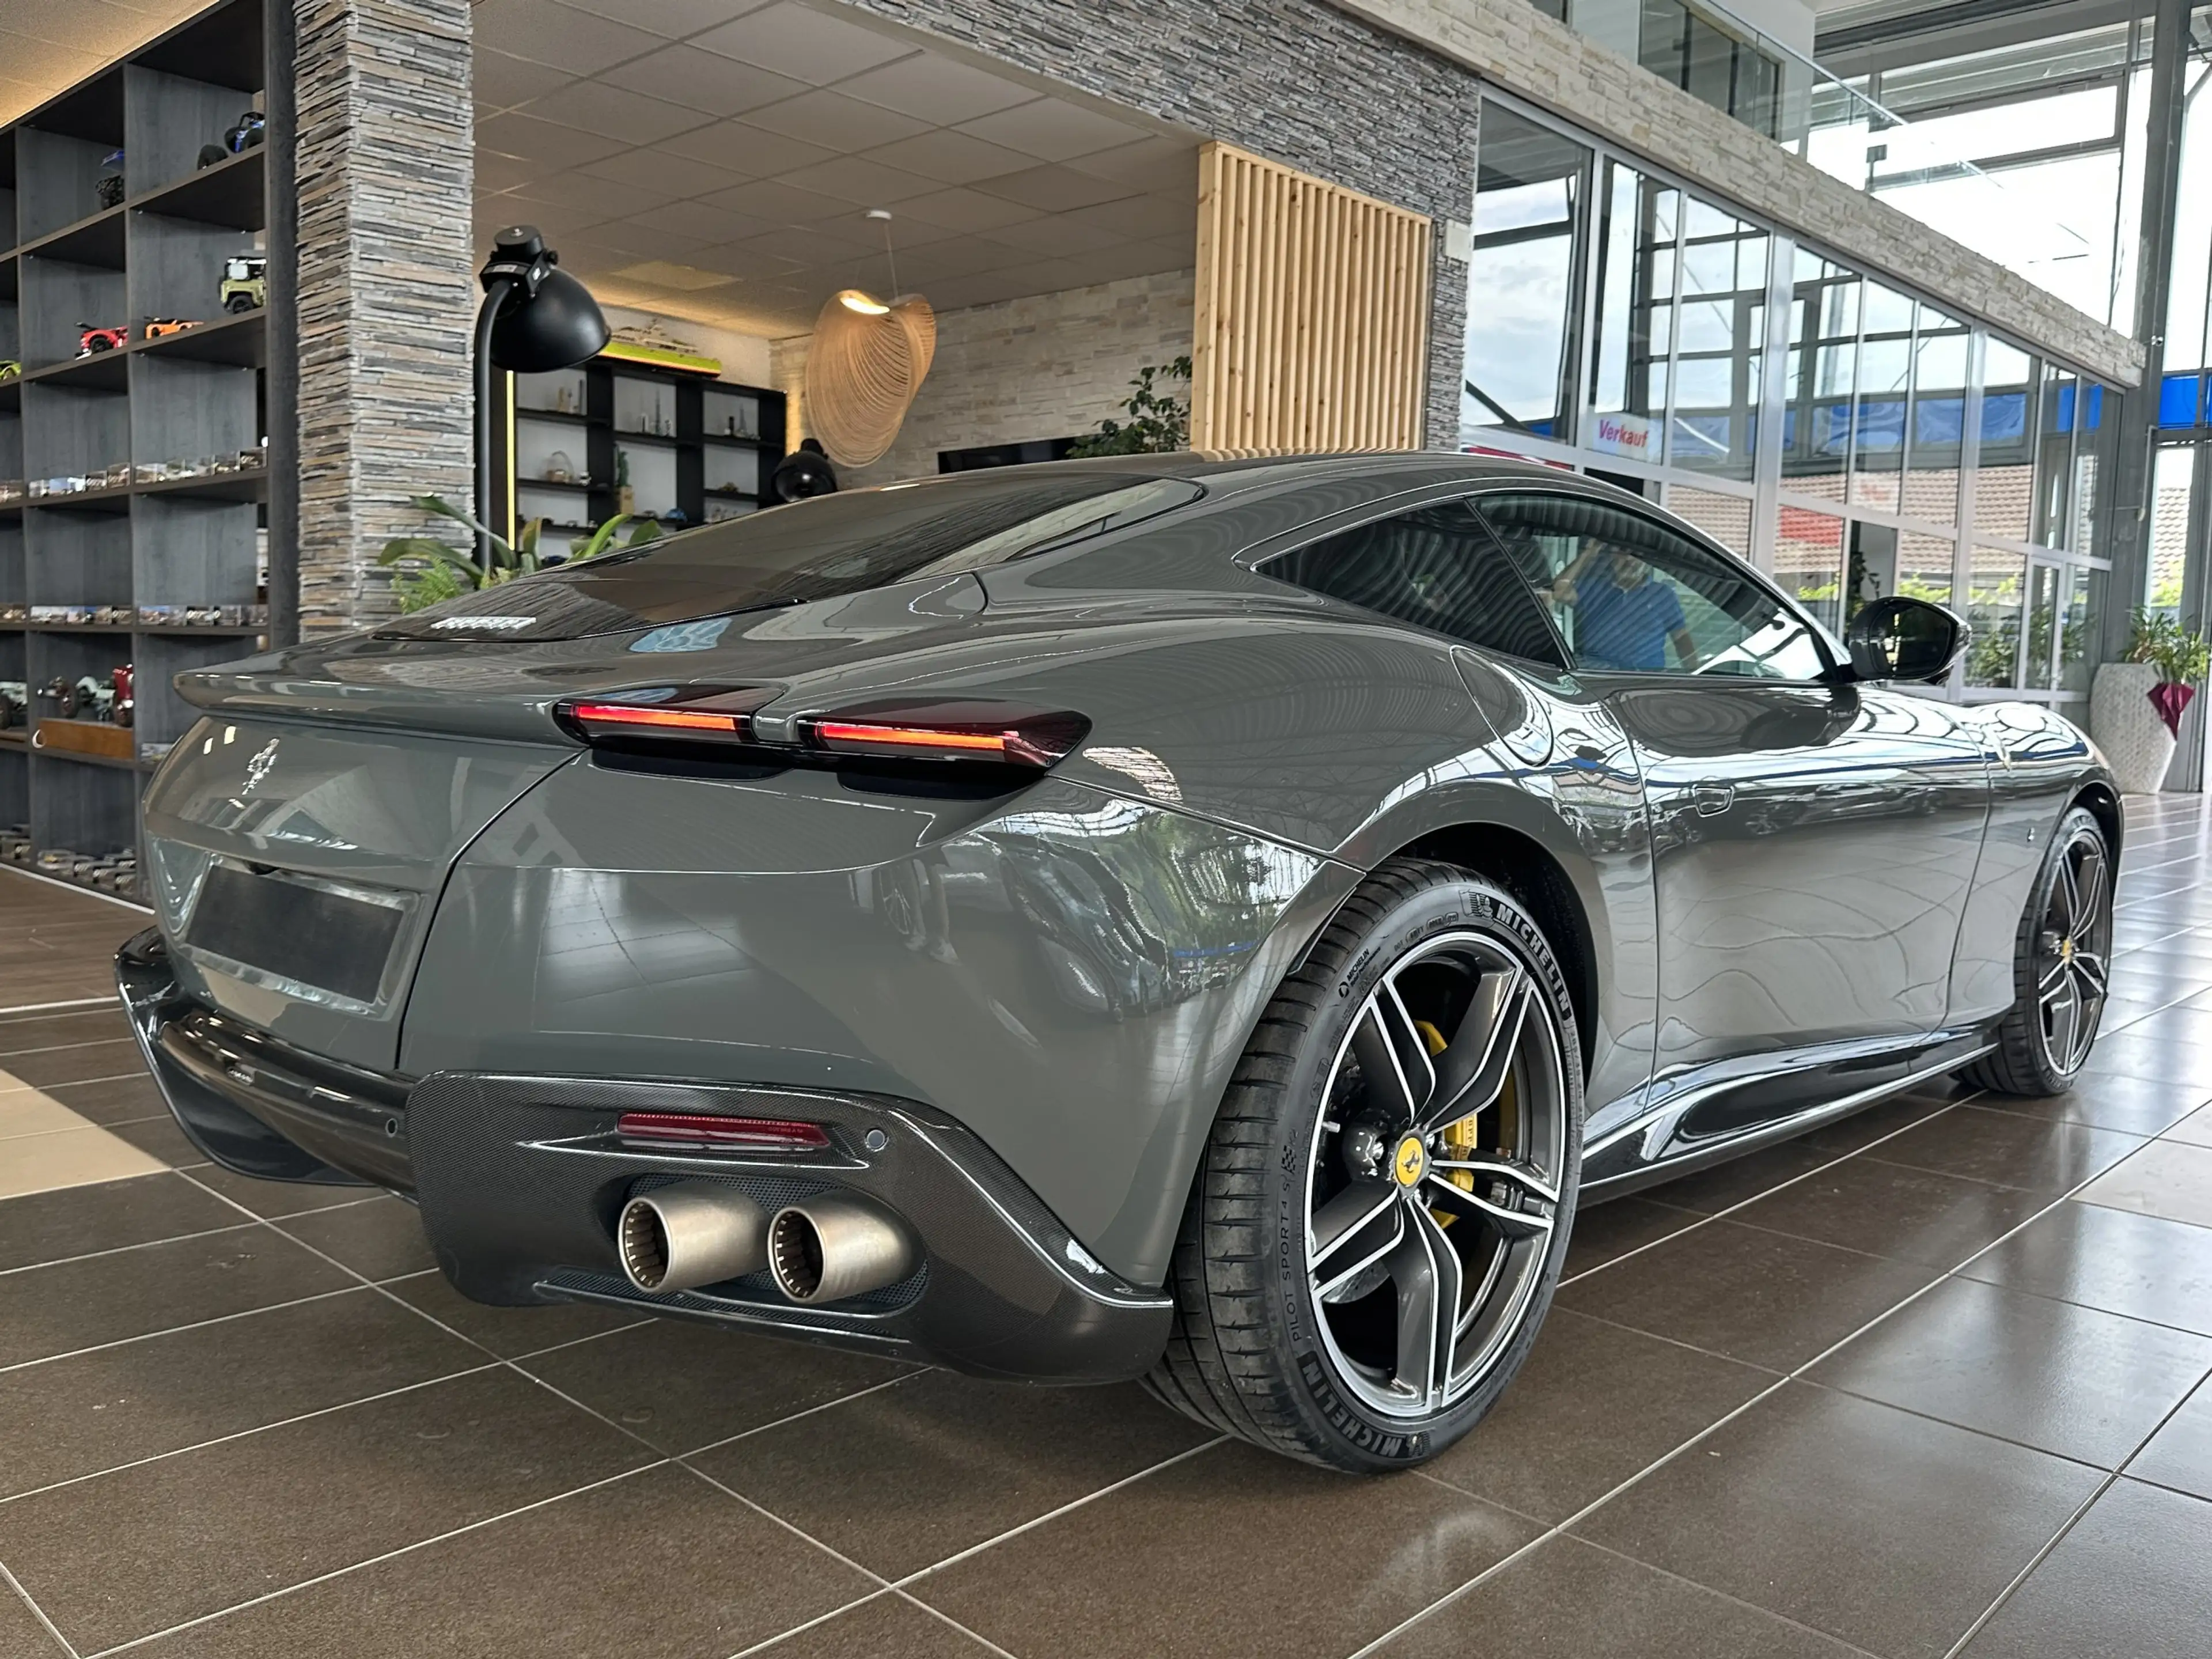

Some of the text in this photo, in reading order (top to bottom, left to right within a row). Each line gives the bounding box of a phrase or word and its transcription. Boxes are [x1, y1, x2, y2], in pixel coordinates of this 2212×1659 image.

[1599, 419, 1649, 448] Verkauf
[1347, 948, 1369, 982] MICHELIN
[1496, 903, 1569, 1012] MICHELIN
[1280, 1212, 1291, 1281] SPORT
[1285, 1291, 1302, 1342] PILOT
[1302, 1361, 1402, 1457] MICHELIN
